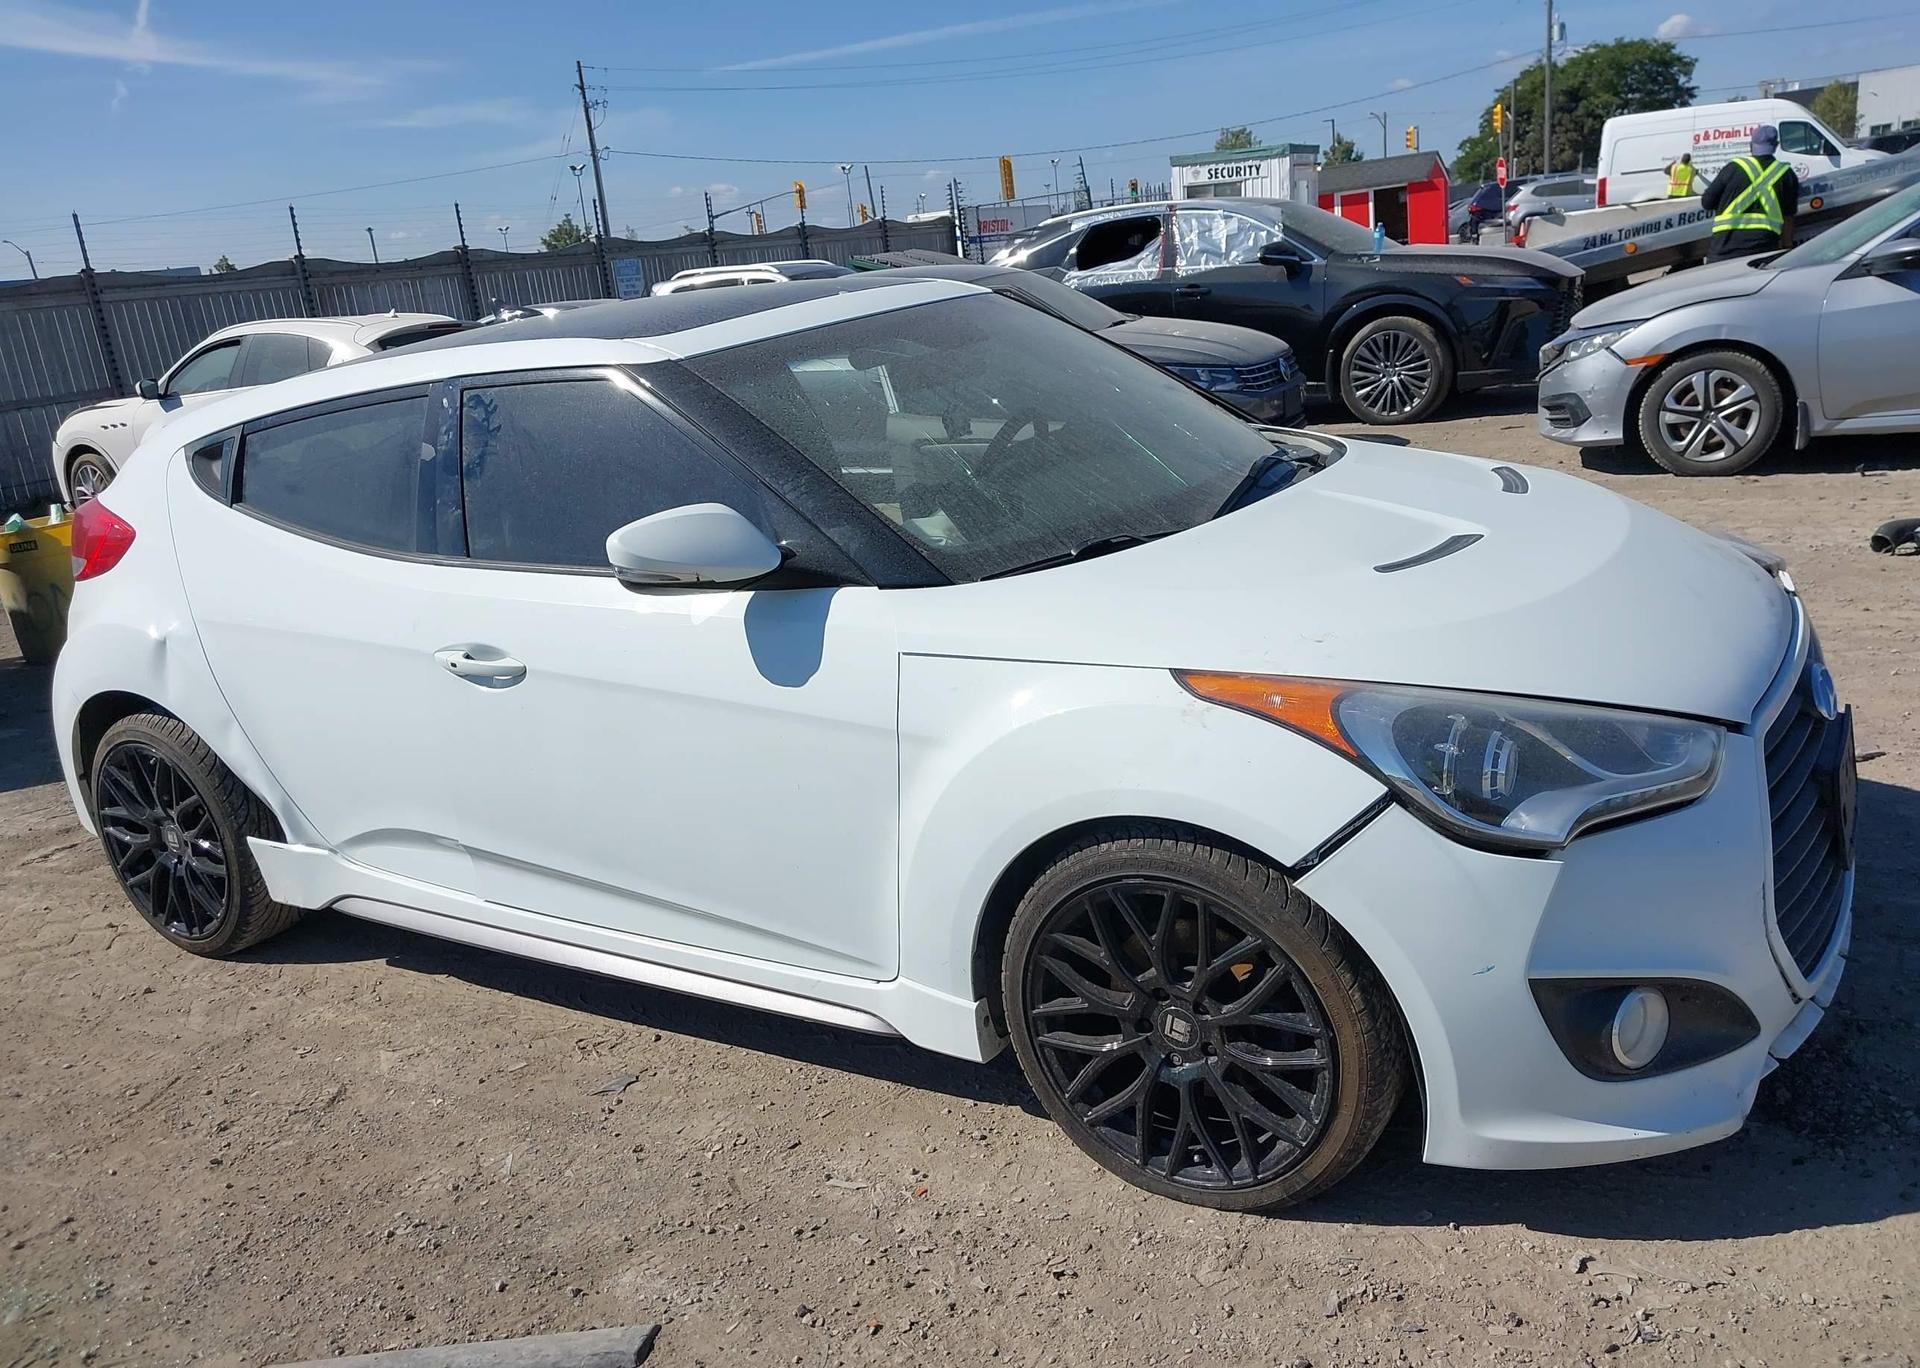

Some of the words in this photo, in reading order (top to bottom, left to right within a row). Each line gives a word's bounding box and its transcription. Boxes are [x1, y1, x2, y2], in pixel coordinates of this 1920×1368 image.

[1693, 134, 1700, 144] g
[1703, 130, 1711, 141] &
[1713, 128, 1741, 140] Drain
[1207, 164, 1262, 180] SECURITY
[1583, 235, 1598, 250] 24
[1600, 232, 1615, 246] Hr.
[1618, 220, 1661, 242] Towing
[1665, 218, 1674, 229] &
[1678, 209, 1715, 227] Reco
